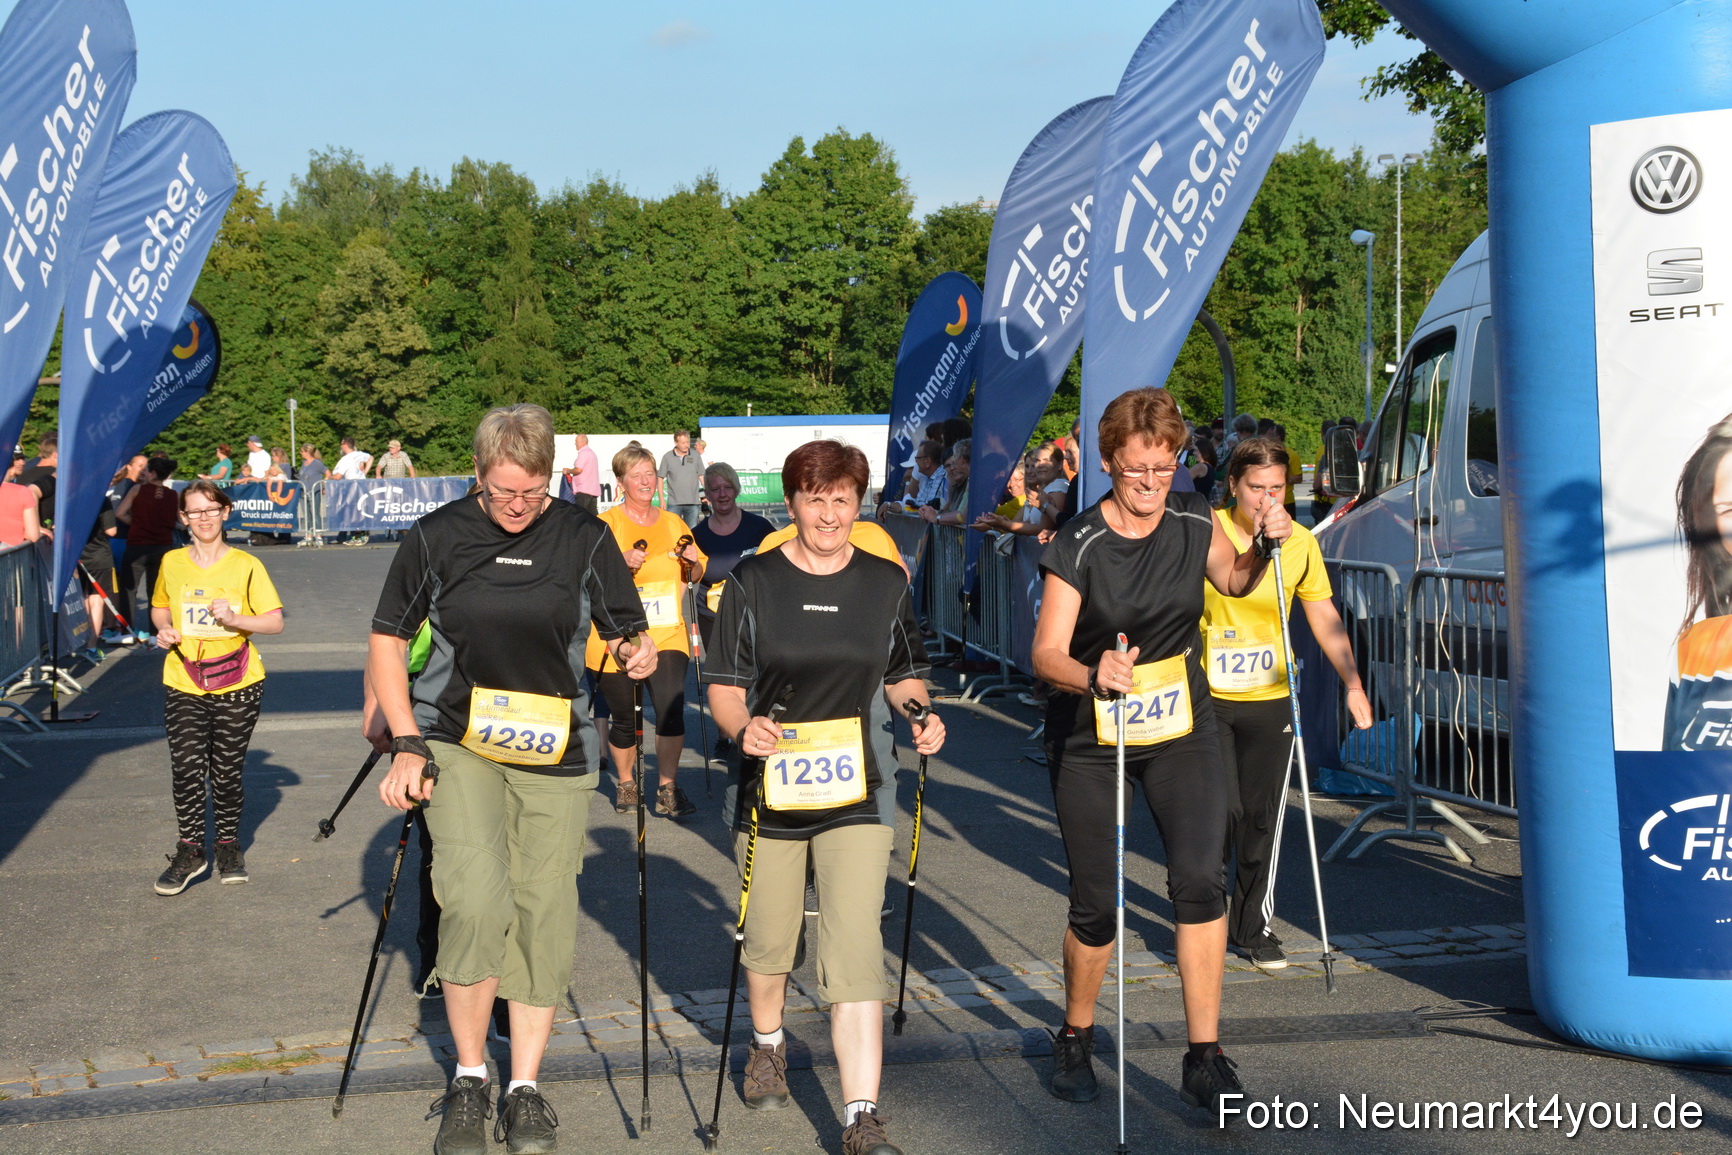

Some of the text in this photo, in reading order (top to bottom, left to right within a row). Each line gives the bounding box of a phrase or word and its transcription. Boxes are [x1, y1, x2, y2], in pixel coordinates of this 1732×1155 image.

[2, 24, 95, 293] Fischer
[1143, 17, 1267, 279] Fischer
[1184, 60, 1284, 272] AUTOMOBILE
[39, 73, 107, 288] AUTOMOBILE
[106, 152, 195, 342] Fischer
[140, 186, 208, 340] AUTOMOBILE
[1629, 303, 1725, 323] SEAT
[146, 386, 171, 413] Druck
[184, 353, 213, 384] Medien
[894, 341, 960, 451] Frischmann
[941, 371, 959, 399] Druck
[953, 352, 966, 375] und
[240, 511, 261, 519] Druck
[186, 607, 219, 626] 12
[1216, 650, 1274, 674] 1270
[1107, 690, 1180, 726] 1247
[478, 724, 557, 755] 1238
[774, 754, 855, 786] 1236
